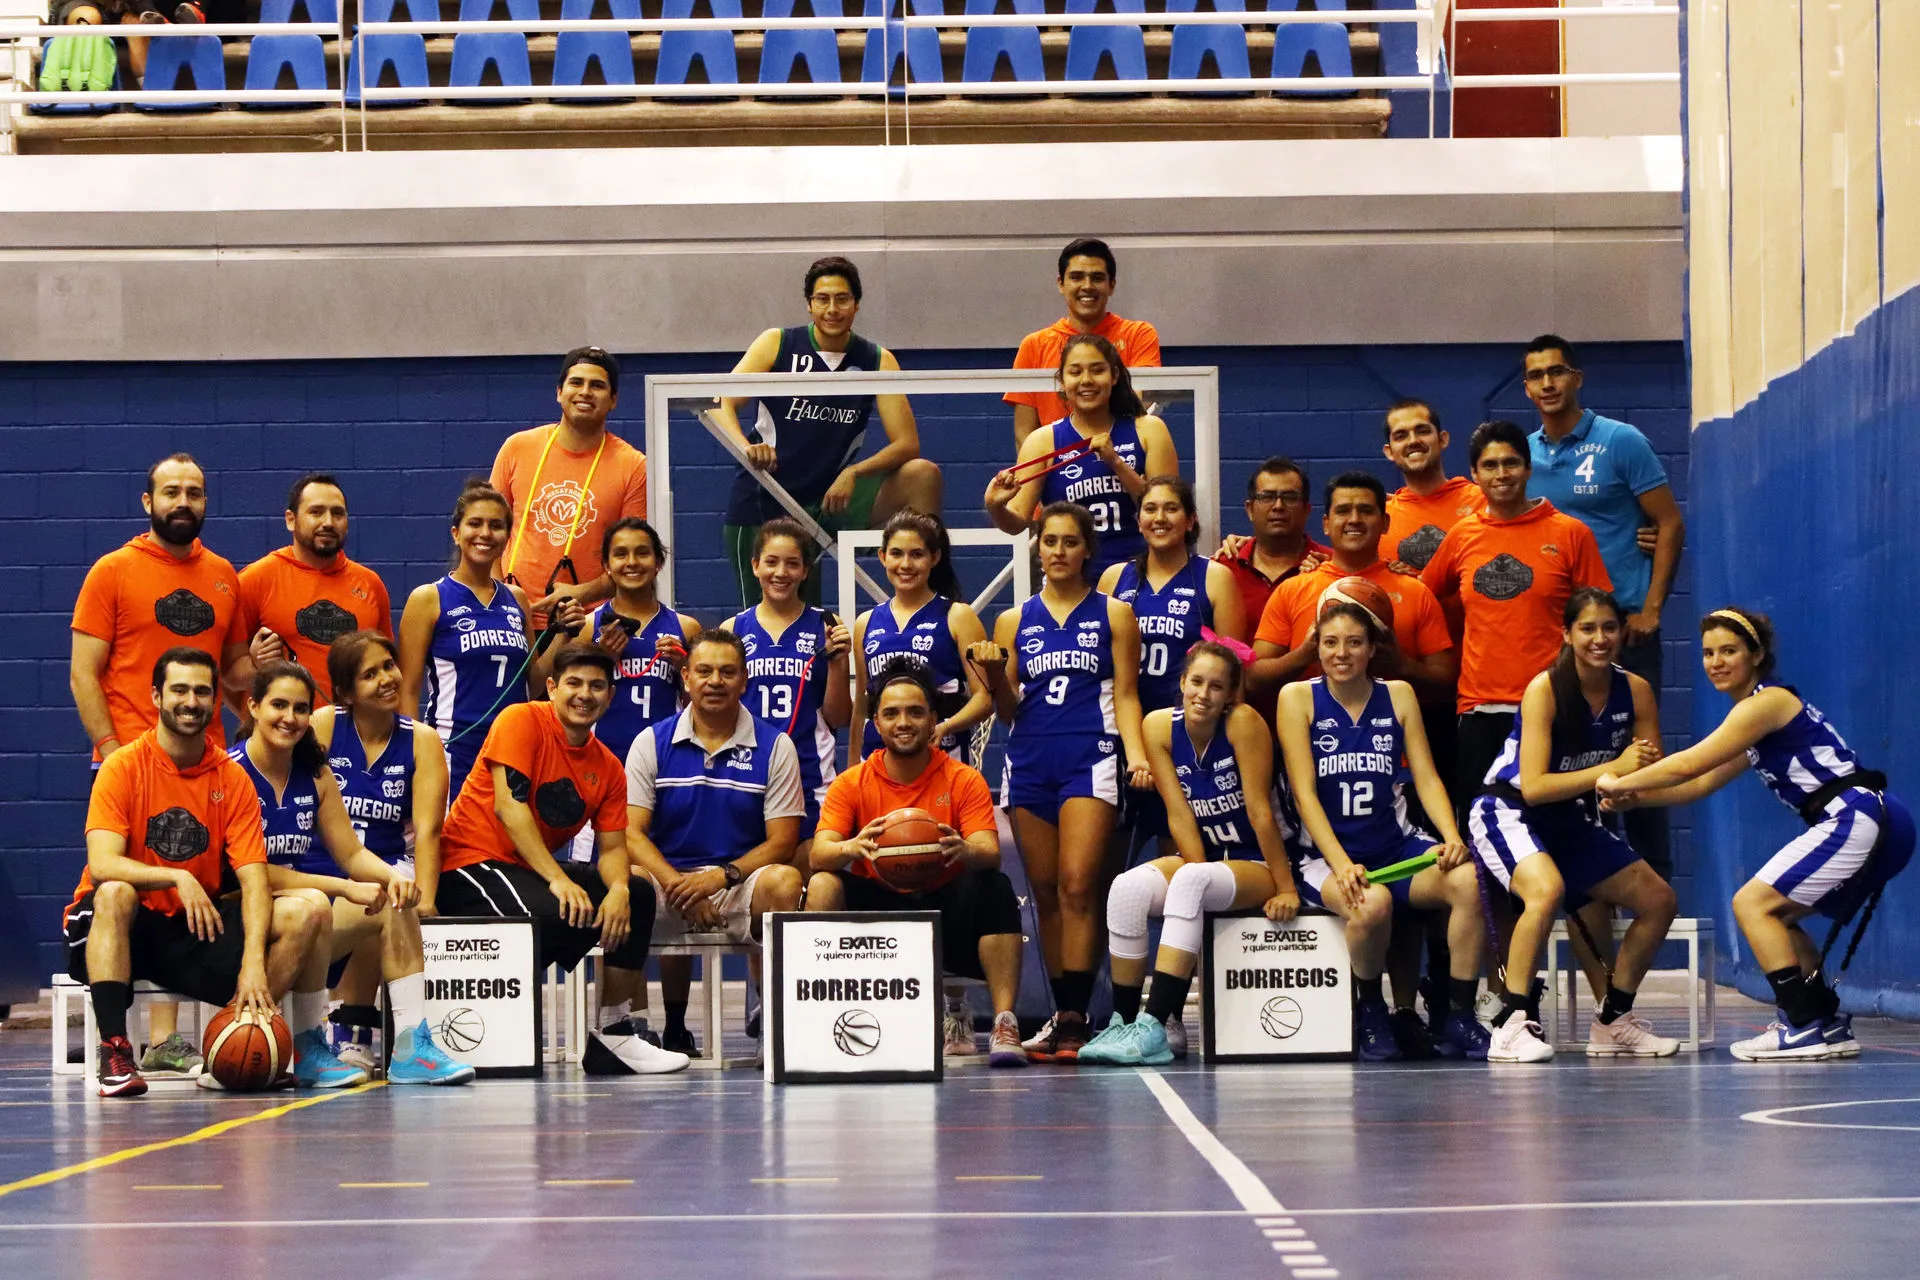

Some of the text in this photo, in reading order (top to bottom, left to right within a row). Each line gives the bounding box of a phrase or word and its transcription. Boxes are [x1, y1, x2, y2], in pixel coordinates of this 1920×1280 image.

[791, 353, 813, 373] 12
[1575, 454, 1595, 483] 4
[1065, 475, 1125, 503] BORREG
[1088, 501, 1122, 532] 31
[1136, 615, 1184, 640] REGOS
[460, 629, 528, 653] BORREGOS
[490, 654, 508, 687] 7
[613, 657, 674, 685] ORREGOS
[746, 657, 813, 682] ORREGOS
[1026, 650, 1099, 679] BORREGOS
[631, 685, 651, 718] 4
[758, 684, 792, 718] 13
[1045, 675, 1070, 705] 9
[1319, 752, 1393, 777] BORREGOS
[342, 796, 401, 822] RREGOS
[1188, 790, 1244, 817] RREGOS
[1339, 781, 1374, 816] 12
[263, 834, 312, 856] RREGOS
[1203, 821, 1243, 846] 14
[422, 939, 500, 951] Soy EXATEC
[814, 937, 898, 949] Soy EXATEC
[1241, 930, 1318, 942] Soy EXATEC
[1242, 943, 1318, 953] y quiero participar
[431, 952, 458, 961] quiero
[460, 952, 500, 961] participar
[815, 950, 898, 960] y quiero participar
[425, 978, 521, 1001] ORREGOS
[797, 978, 920, 1001] BORREGOS
[1226, 967, 1338, 990] BORREGOS
